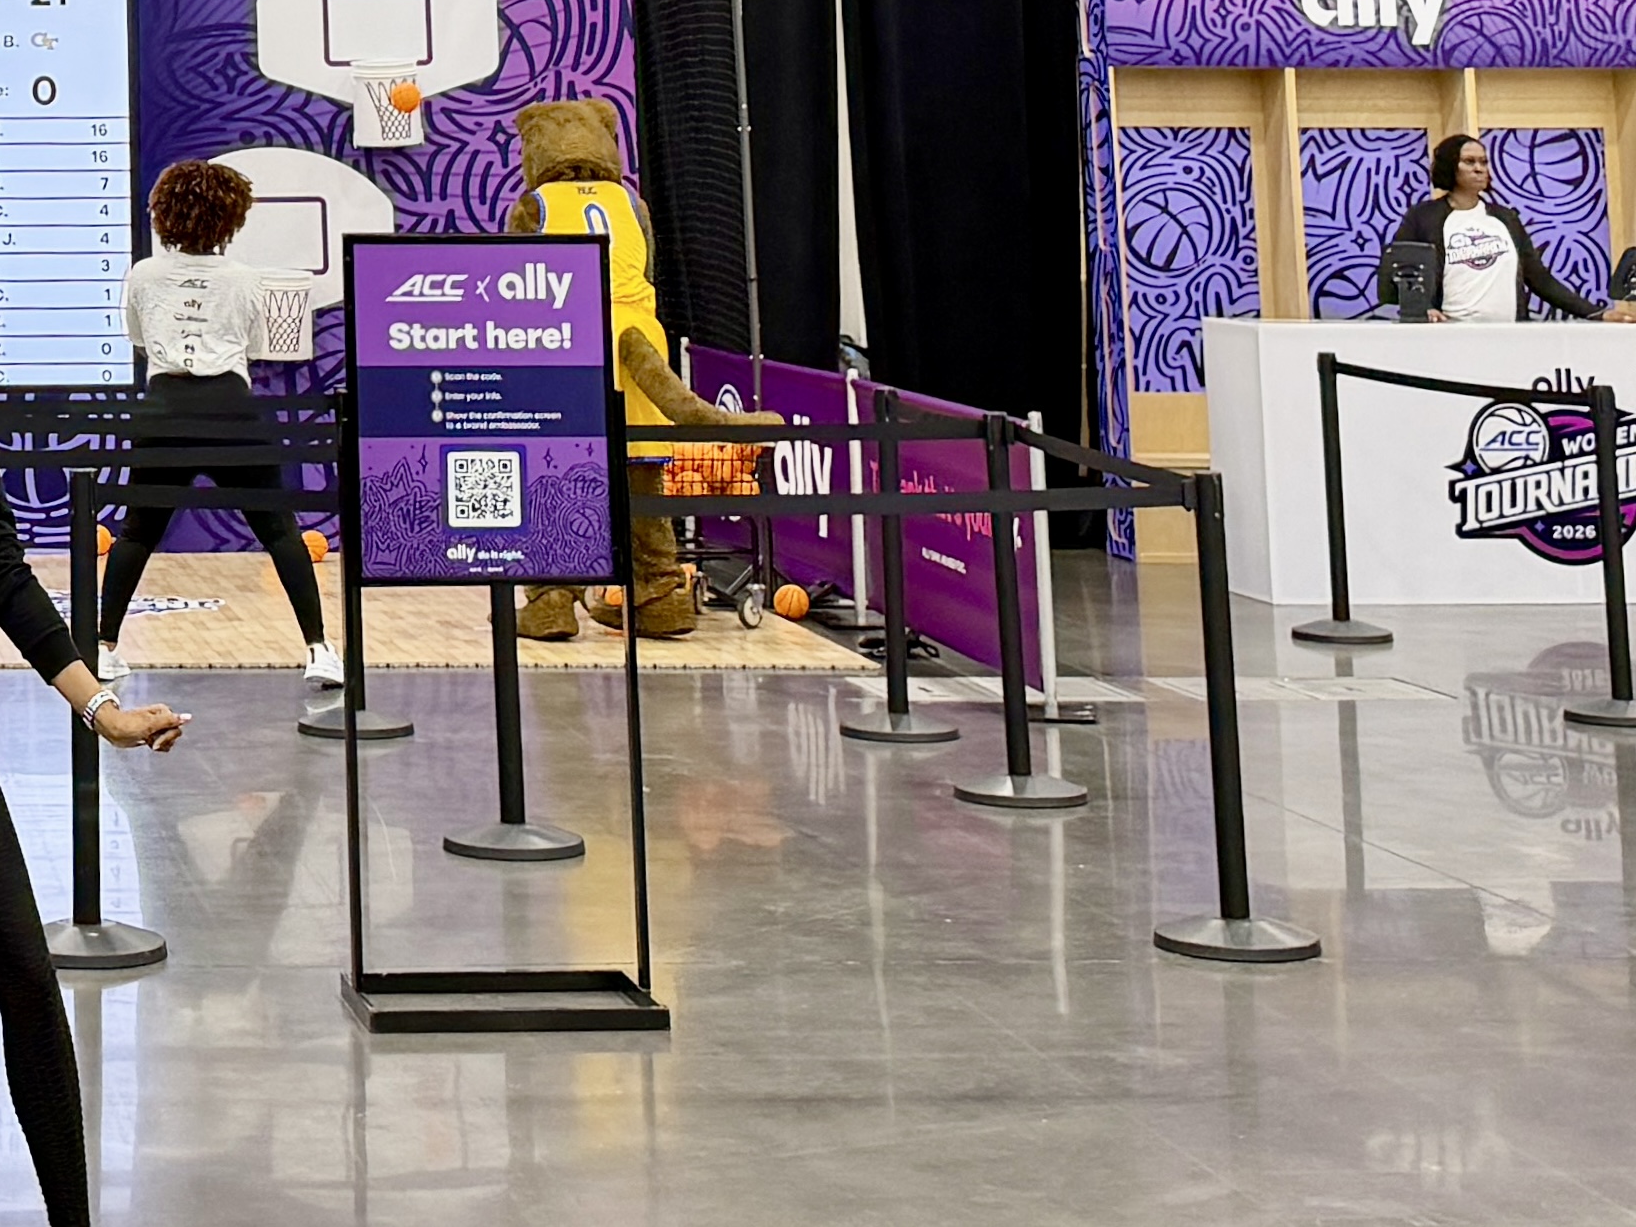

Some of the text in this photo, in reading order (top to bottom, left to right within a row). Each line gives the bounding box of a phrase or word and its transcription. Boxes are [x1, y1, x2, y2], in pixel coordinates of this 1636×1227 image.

[4, 35, 20, 48] B.
[32, 75, 57, 106] 0
[91, 123, 108, 136] 16
[91, 150, 108, 163] 16
[100, 177, 109, 190] 7
[99, 204, 110, 217] 4
[2, 232, 17, 247] J.
[99, 232, 110, 245] 4
[101, 259, 111, 272] 3
[385, 274, 469, 302] ACC
[497, 262, 573, 310] ally
[104, 288, 112, 301] 1
[104, 314, 112, 327] 1
[389, 320, 573, 350] Start here!
[101, 342, 113, 356] 0
[1479, 430, 1542, 452] ACC
[773, 414, 832, 539] ally
[1552, 524, 1597, 540] 2026
[446, 543, 476, 563] ally
